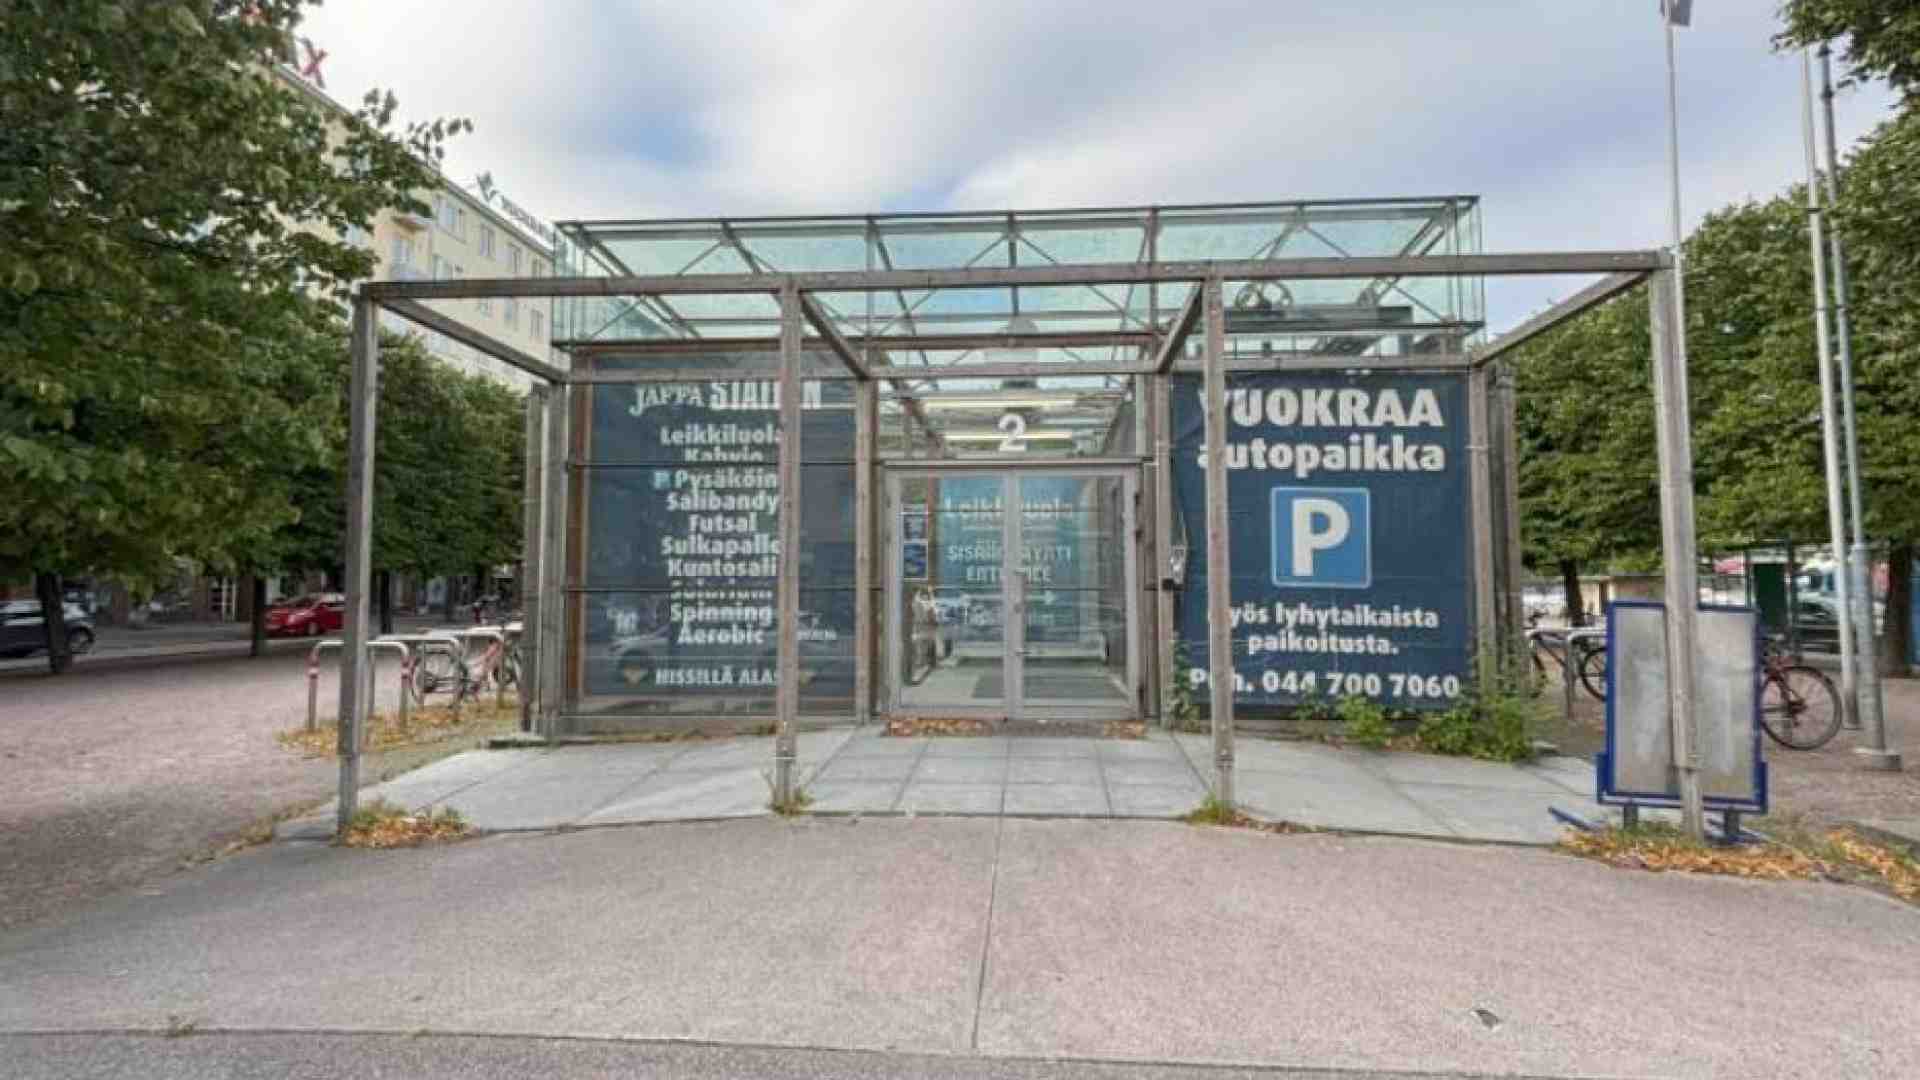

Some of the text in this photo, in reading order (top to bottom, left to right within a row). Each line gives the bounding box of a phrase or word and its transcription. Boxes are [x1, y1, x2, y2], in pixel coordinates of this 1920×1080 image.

[1000, 413, 1027, 451] 2
[674, 467, 778, 496] Pysäköin
[666, 490, 778, 515] Salibandy
[689, 511, 756, 532] Futsal
[1293, 498, 1351, 577] P
[667, 554, 777, 577] Kuntosali
[670, 600, 773, 628] Spinning
[1209, 602, 1439, 630] yös lyhytaikaista
[677, 623, 765, 645] Aerobic
[1189, 667, 1460, 698] Ph. 044 700 7060
